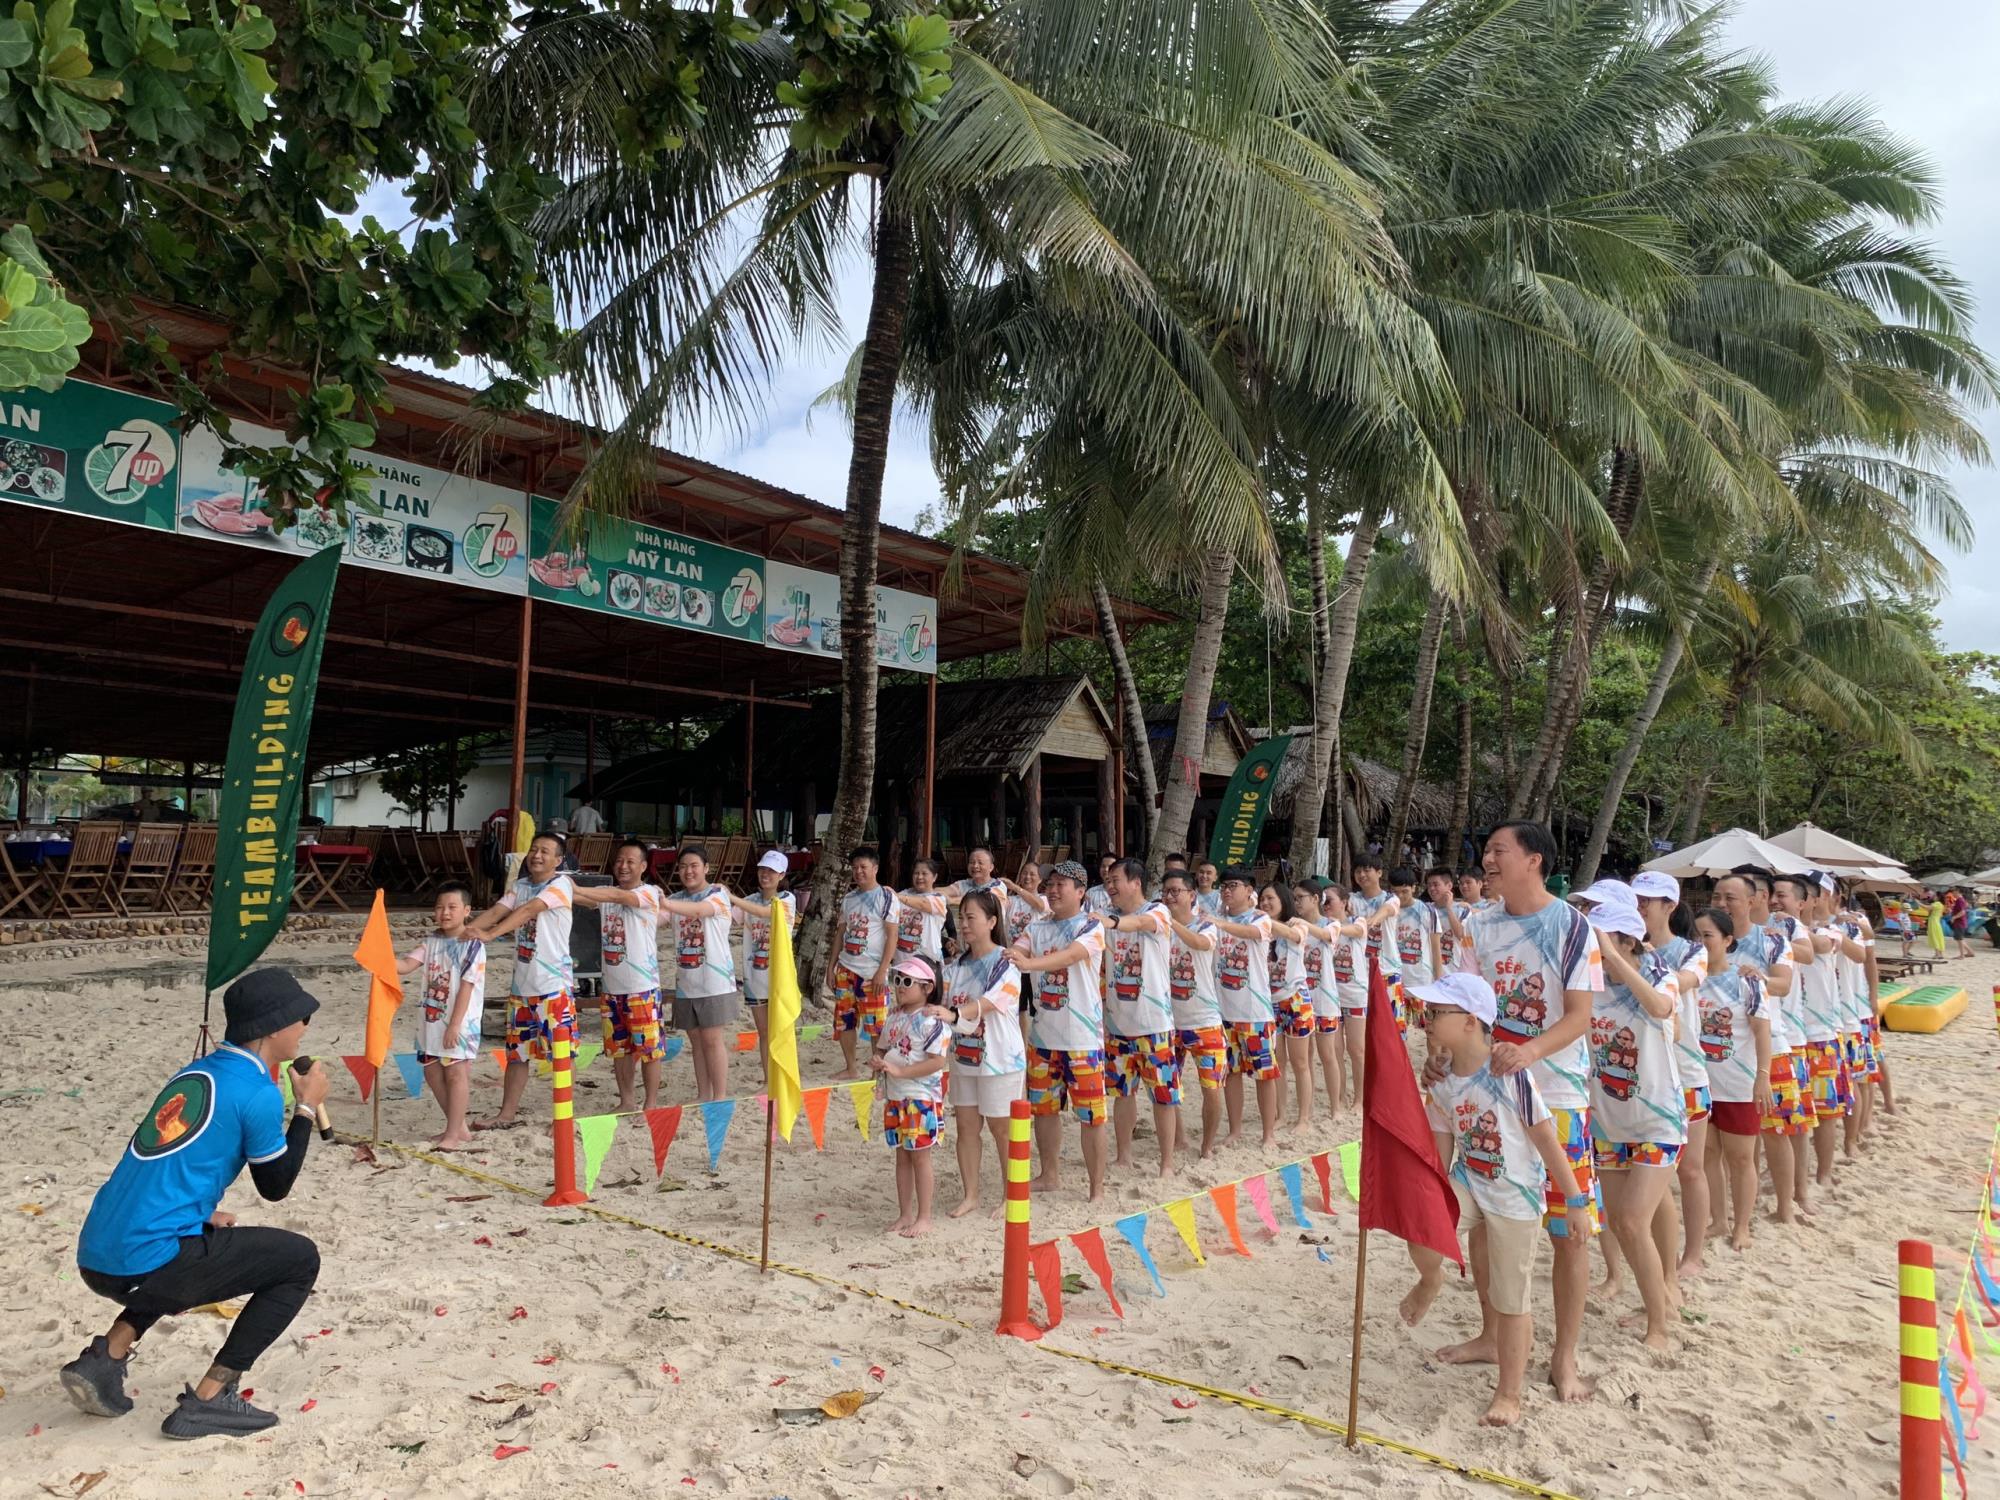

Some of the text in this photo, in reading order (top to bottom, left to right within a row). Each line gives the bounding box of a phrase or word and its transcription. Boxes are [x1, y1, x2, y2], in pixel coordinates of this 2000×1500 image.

[379, 466, 421, 487] HÀNG
[379, 489, 430, 518] LAN
[635, 531, 696, 557] NHÀ HÀNG
[664, 557, 704, 581] LAN
[239, 673, 295, 927] TEAMBUILDING
